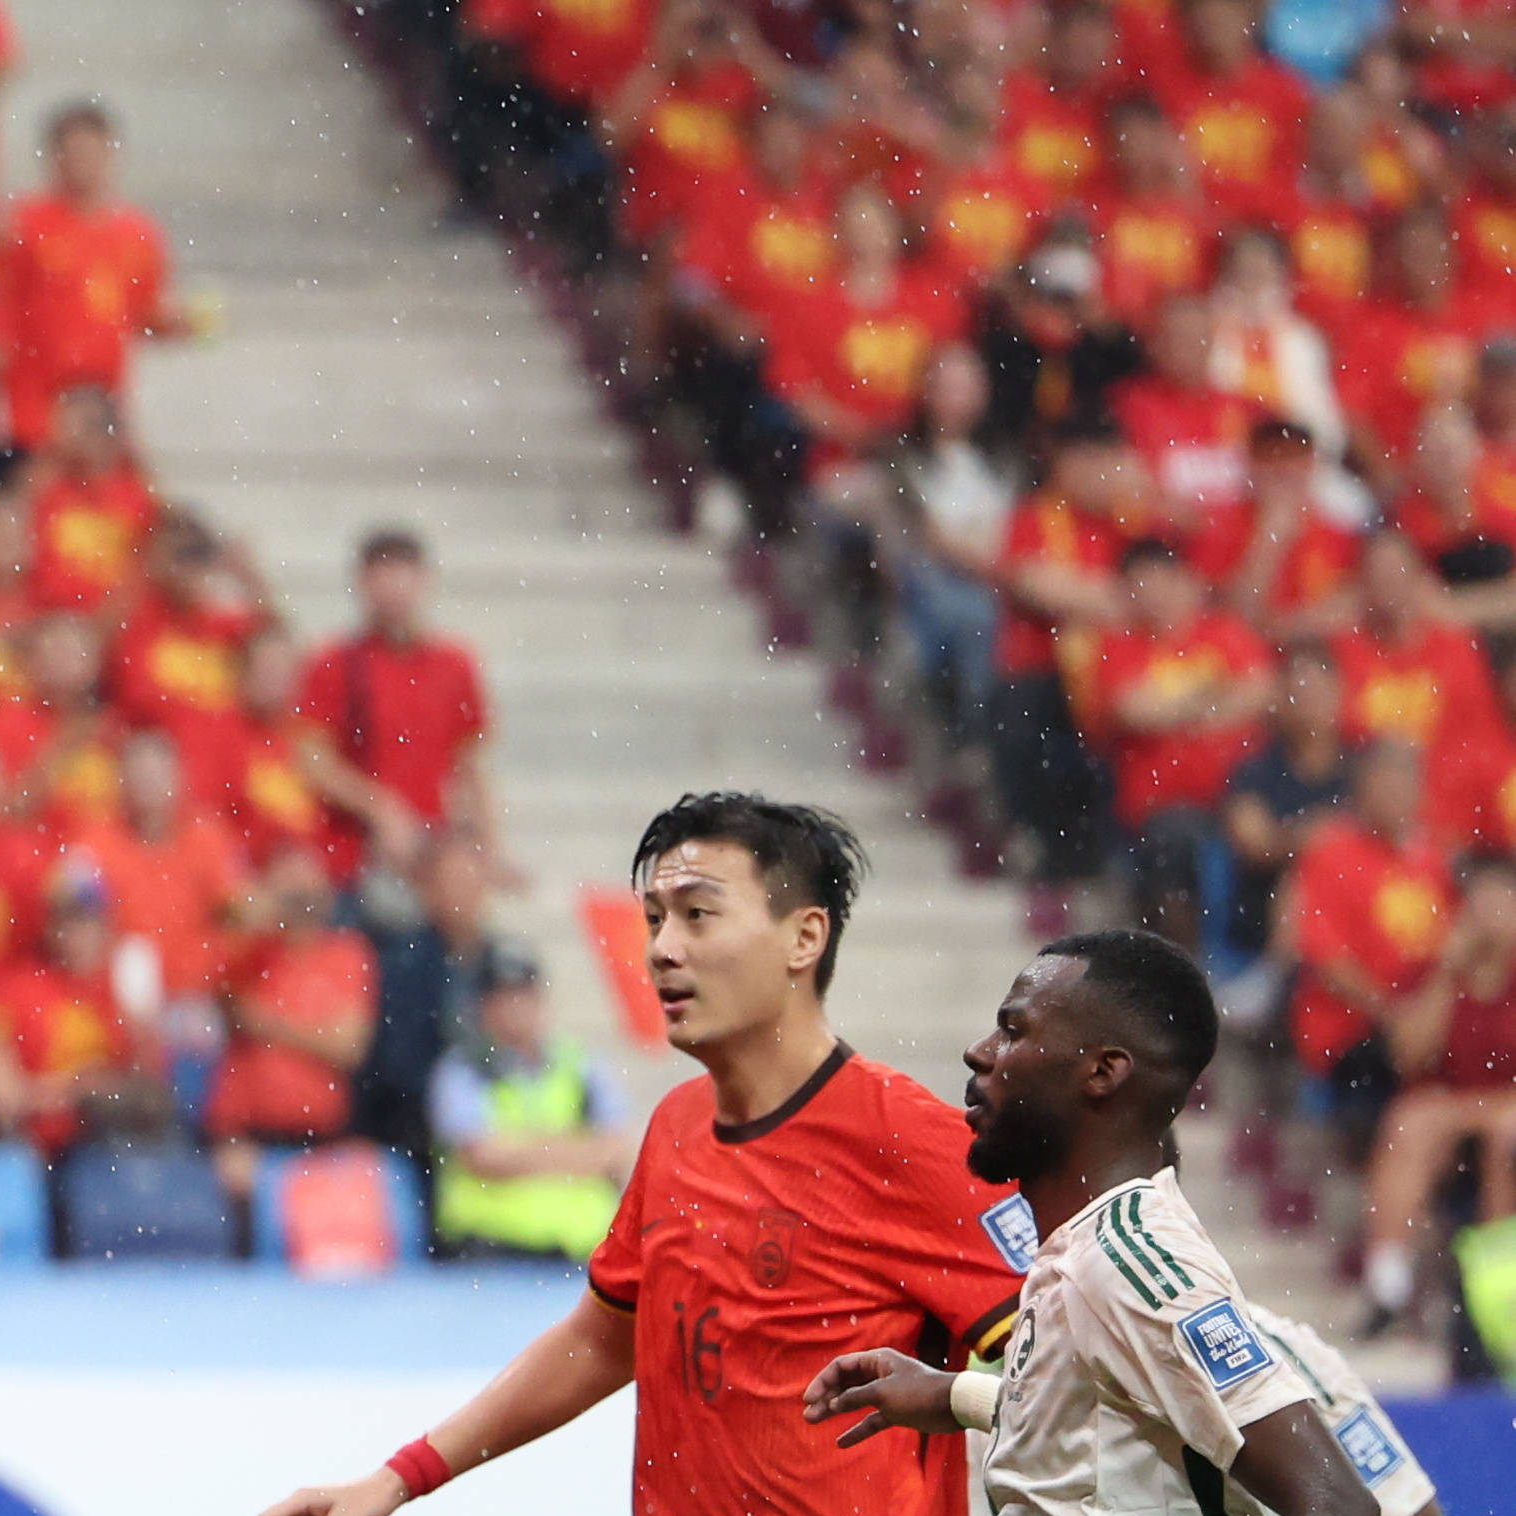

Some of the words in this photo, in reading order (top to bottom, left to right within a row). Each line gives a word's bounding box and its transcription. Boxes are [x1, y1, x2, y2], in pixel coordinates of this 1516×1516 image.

[1196, 1313, 1233, 1335] FOOTBALL
[1203, 1322, 1242, 1348] UNITES
[673, 1301, 723, 1400] 16
